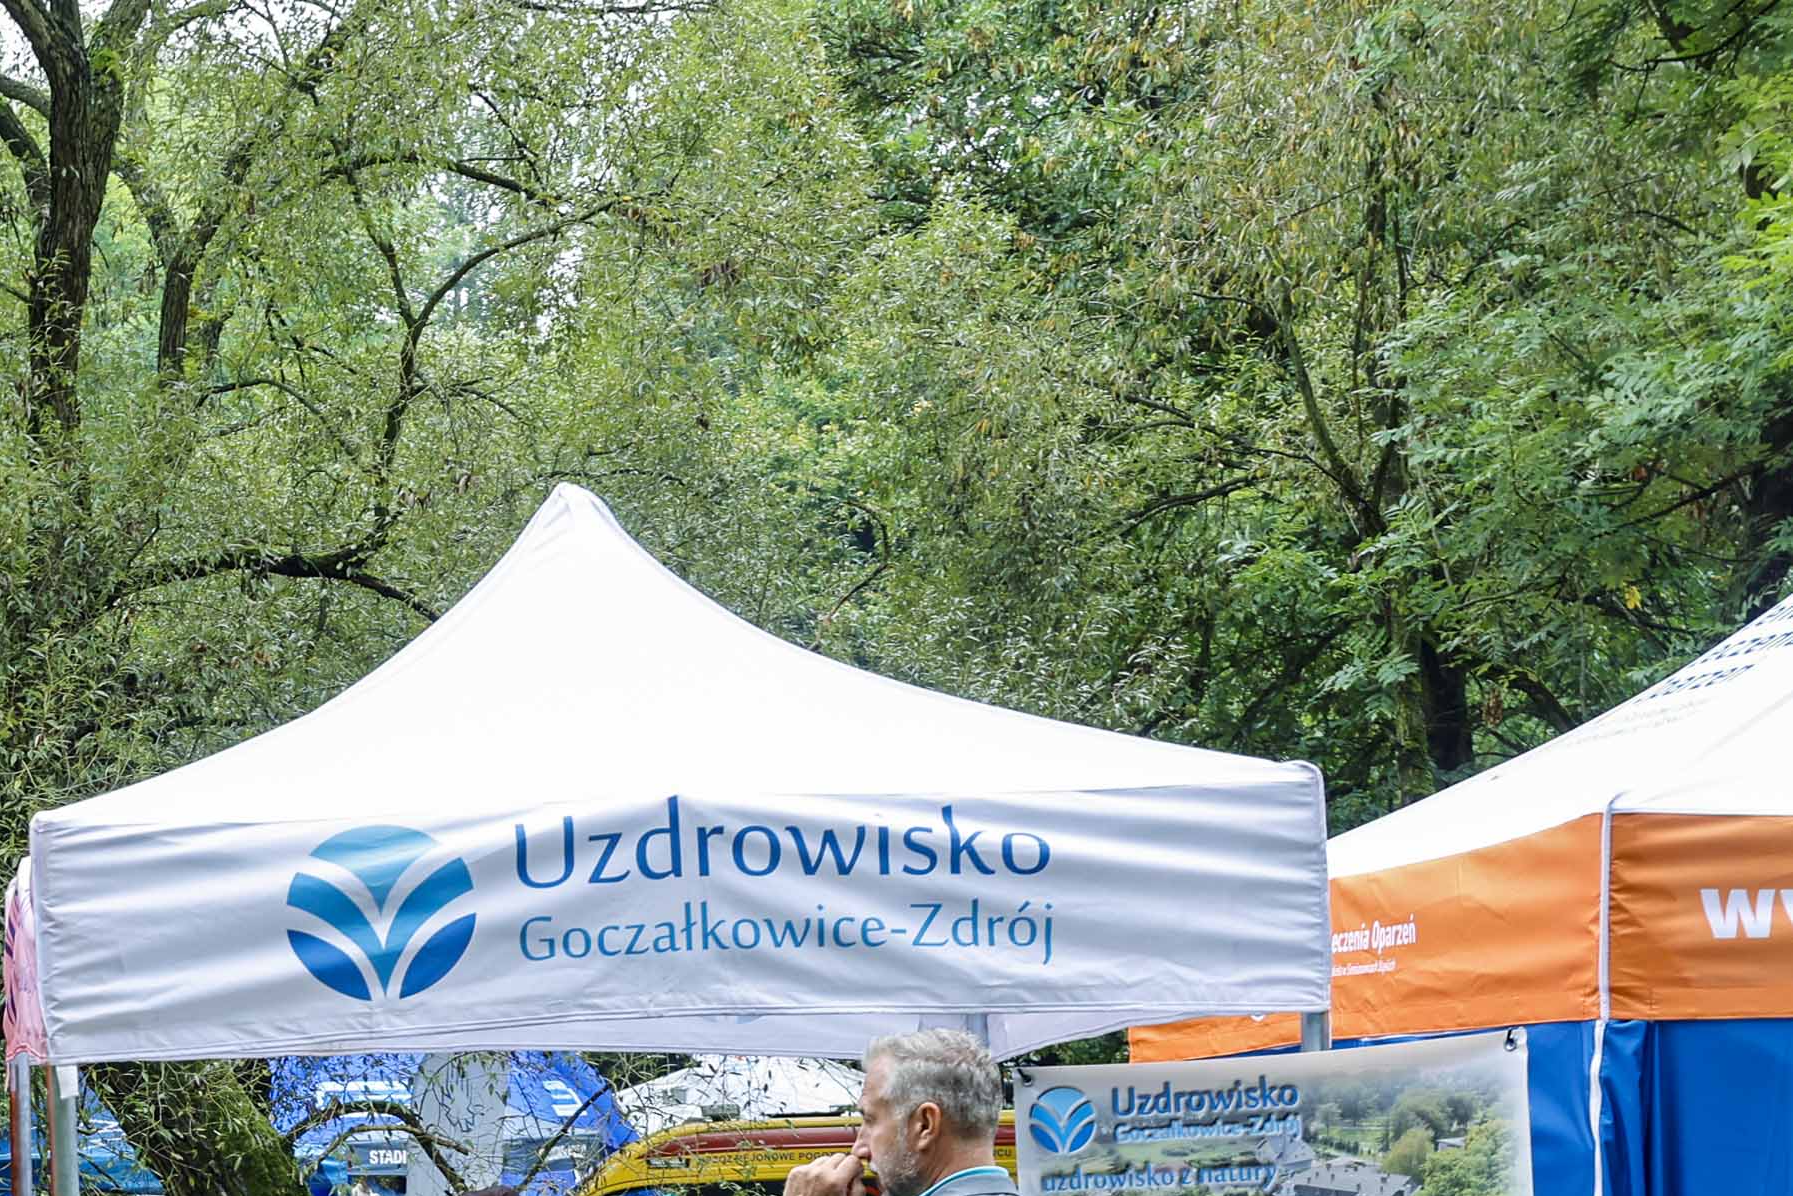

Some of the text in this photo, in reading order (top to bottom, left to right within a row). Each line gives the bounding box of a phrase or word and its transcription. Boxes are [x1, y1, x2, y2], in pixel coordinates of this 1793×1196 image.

[515, 794, 1052, 889] Uzdrowisko
[519, 898, 1055, 966] Goczałkowice-Zdrój
[1372, 912, 1416, 954] Oparzeń
[1111, 1074, 1300, 1117] Uzdrowisko
[1041, 1161, 1278, 1192] uzdrowisko z natury
